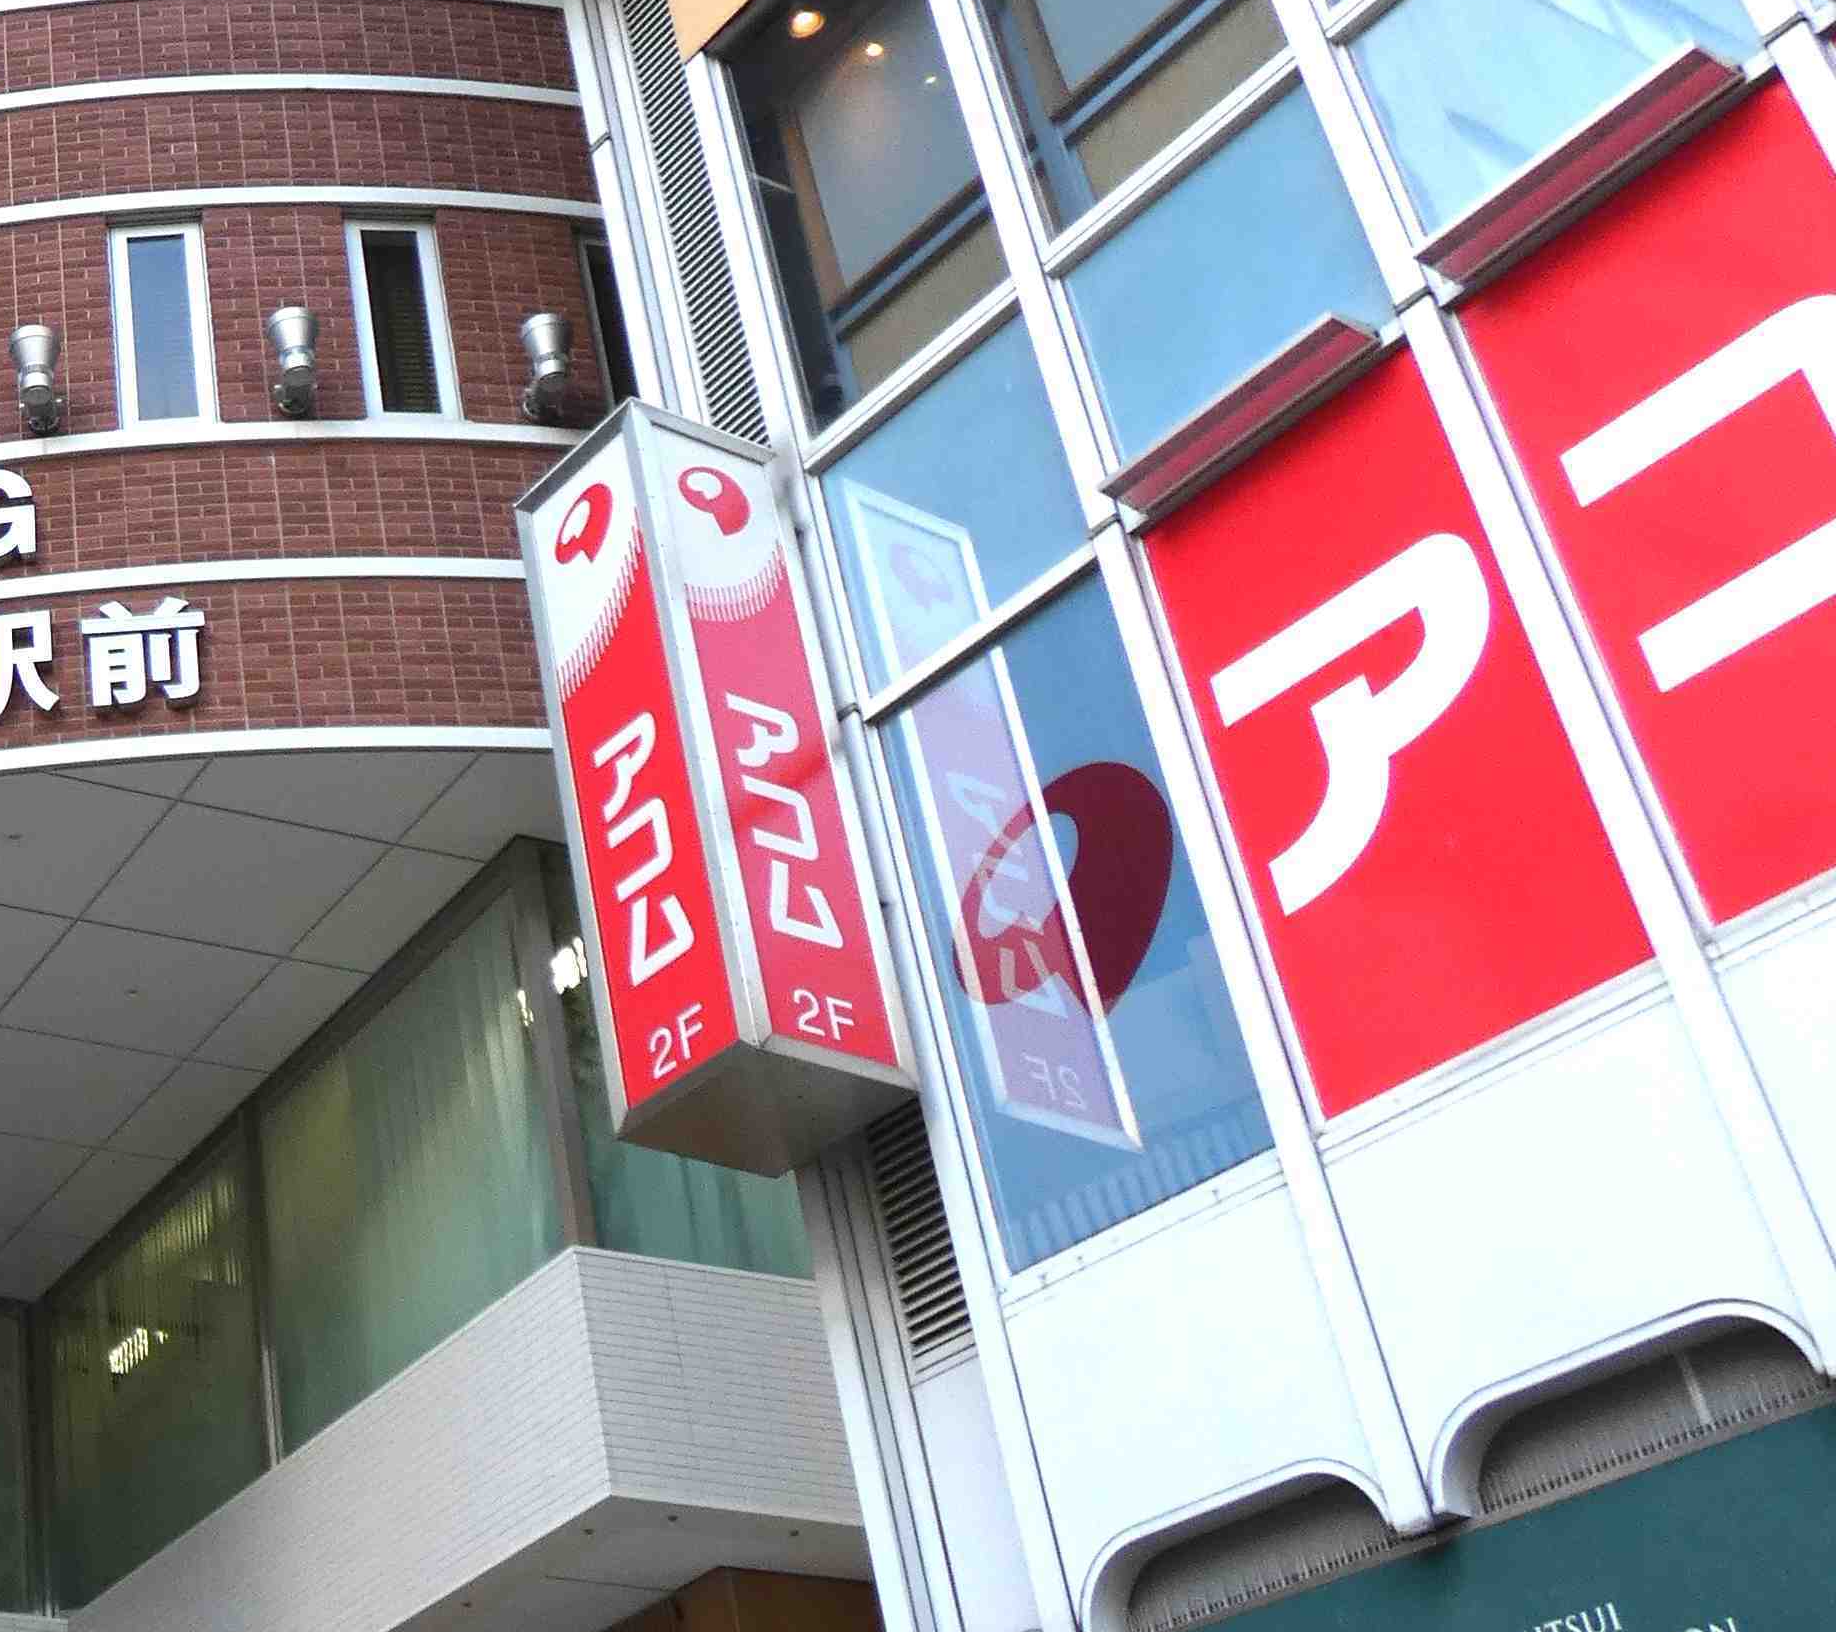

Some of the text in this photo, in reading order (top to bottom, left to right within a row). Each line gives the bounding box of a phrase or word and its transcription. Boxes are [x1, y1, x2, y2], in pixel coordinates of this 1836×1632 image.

[592, 710, 696, 989] アコム
[724, 690, 845, 951] アコム
[648, 1001, 706, 1081] 2F
[791, 987, 856, 1043] 2F
